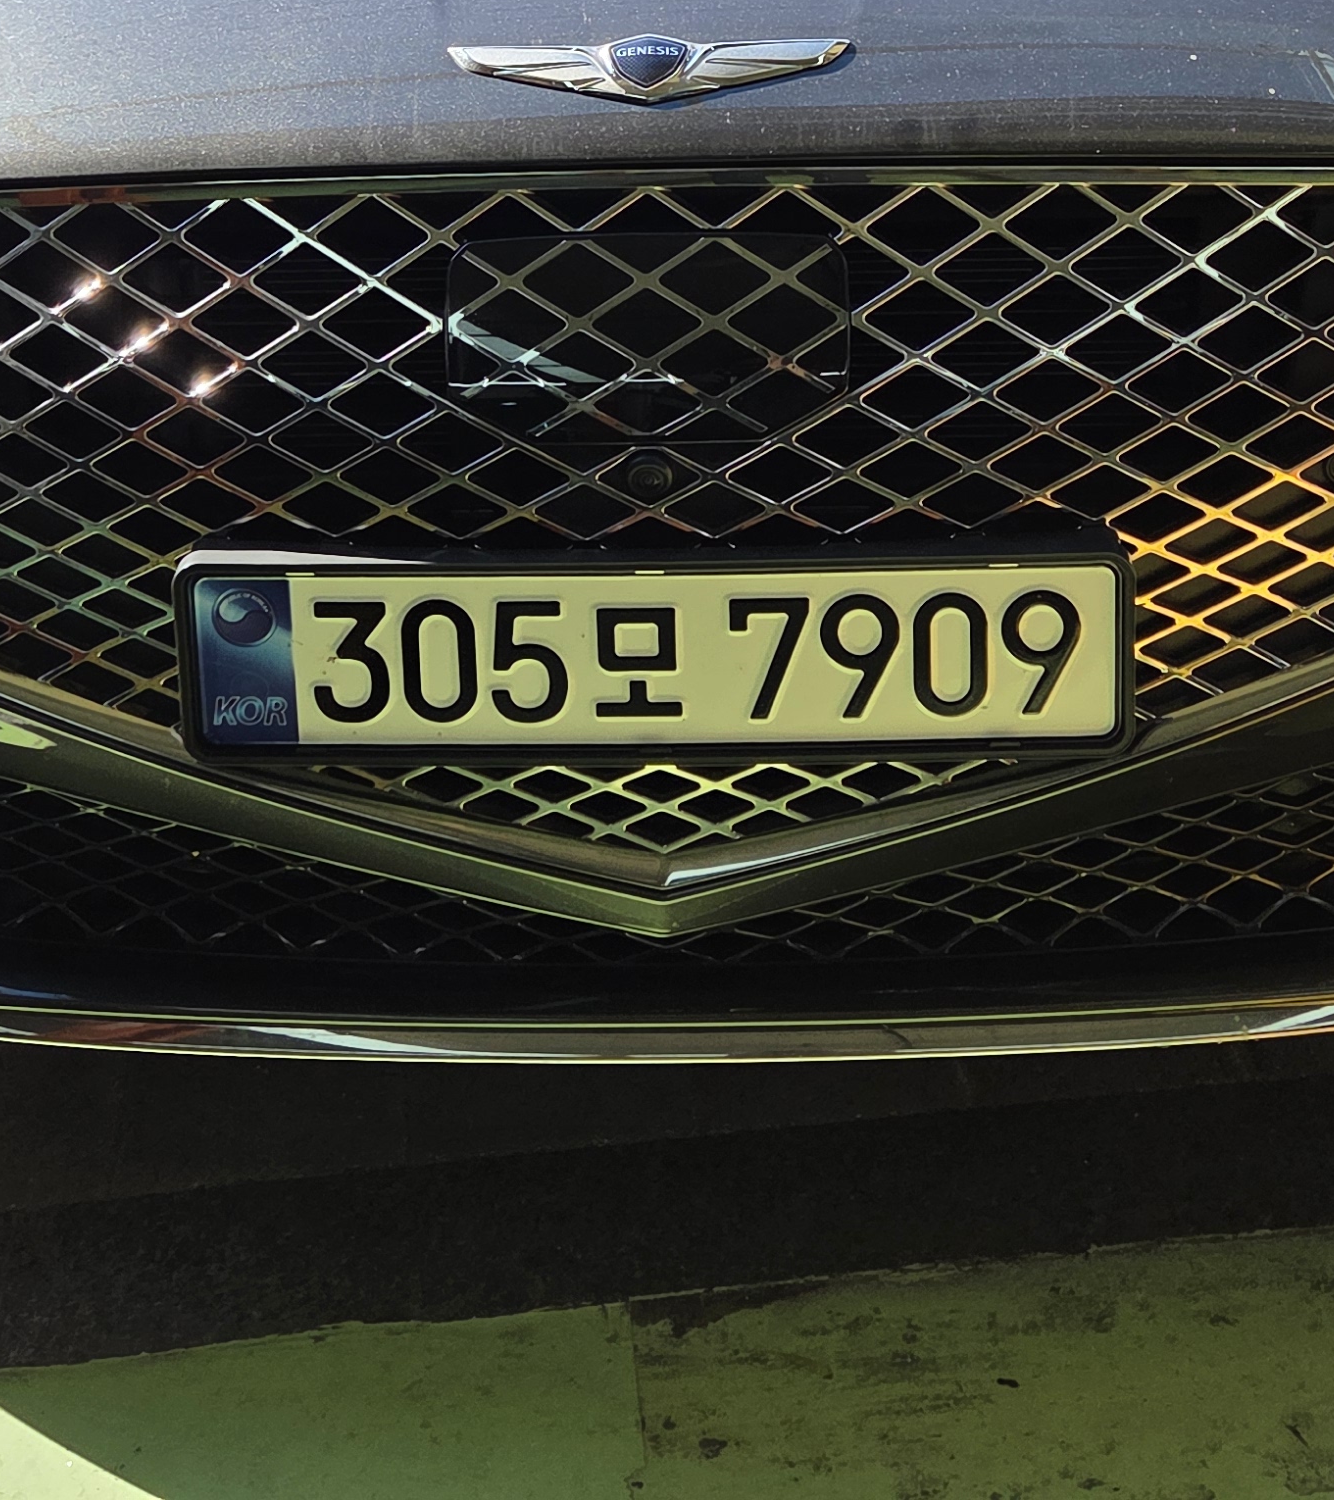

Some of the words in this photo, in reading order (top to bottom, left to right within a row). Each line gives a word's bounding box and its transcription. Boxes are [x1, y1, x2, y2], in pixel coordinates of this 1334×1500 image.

[615, 45, 679, 57] GENESIS
[311, 598, 684, 724] 305모
[727, 590, 1082, 720] 7909
[212, 695, 288, 726] KOR
